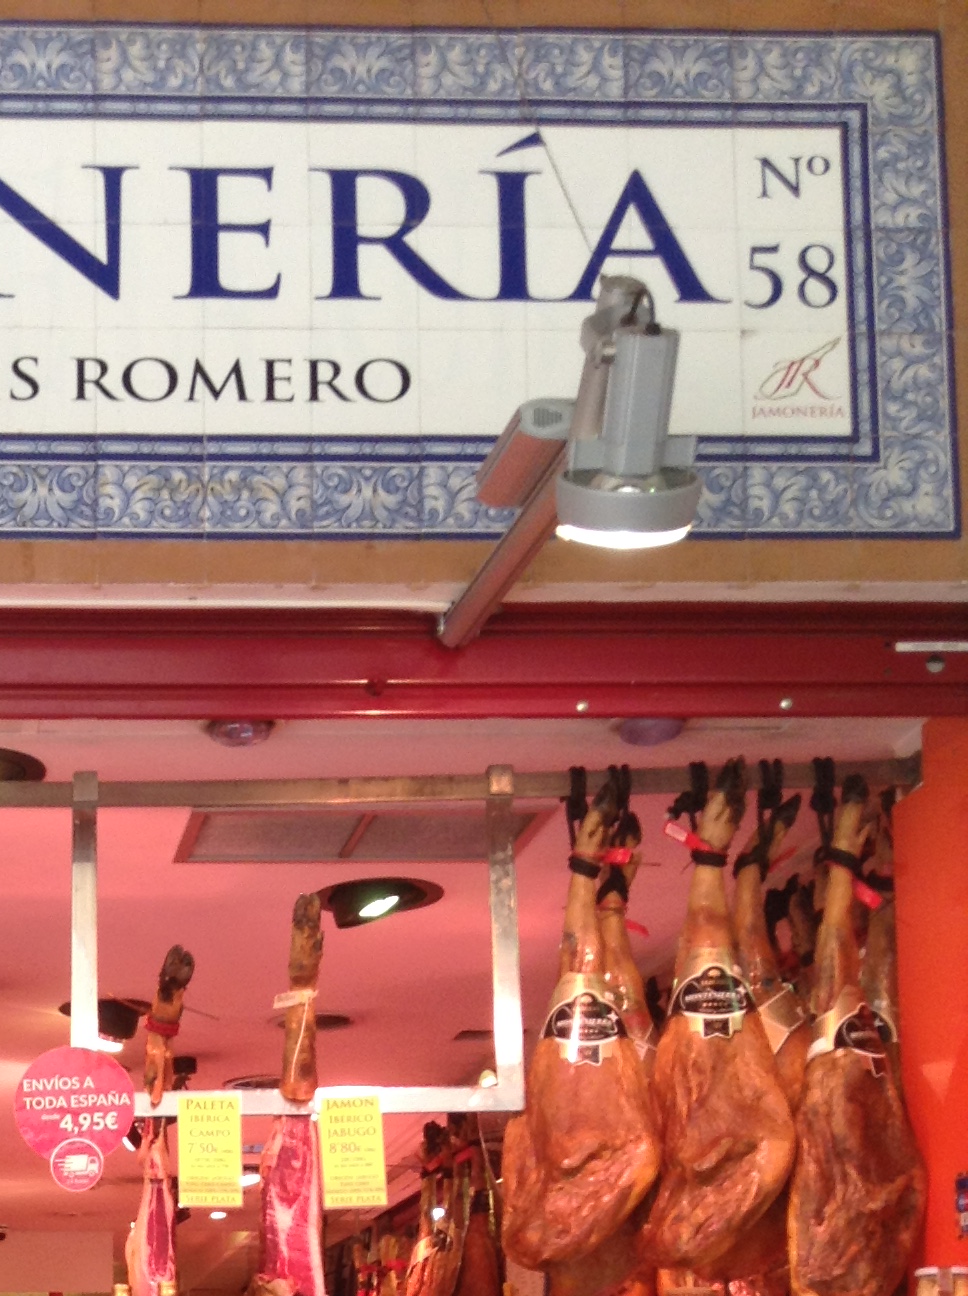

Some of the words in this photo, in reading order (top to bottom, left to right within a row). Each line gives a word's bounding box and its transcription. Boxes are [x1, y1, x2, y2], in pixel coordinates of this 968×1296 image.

[743, 243, 838, 310] 58
[70, 356, 413, 403] ROMERO
[22, 1074, 80, 1092] ENVÍOS
[83, 1076, 95, 1088] A
[23, 1096, 68, 1110] TODA
[70, 1090, 131, 1108] ESPAÑA
[59, 1112, 118, 1135] 4,95€
